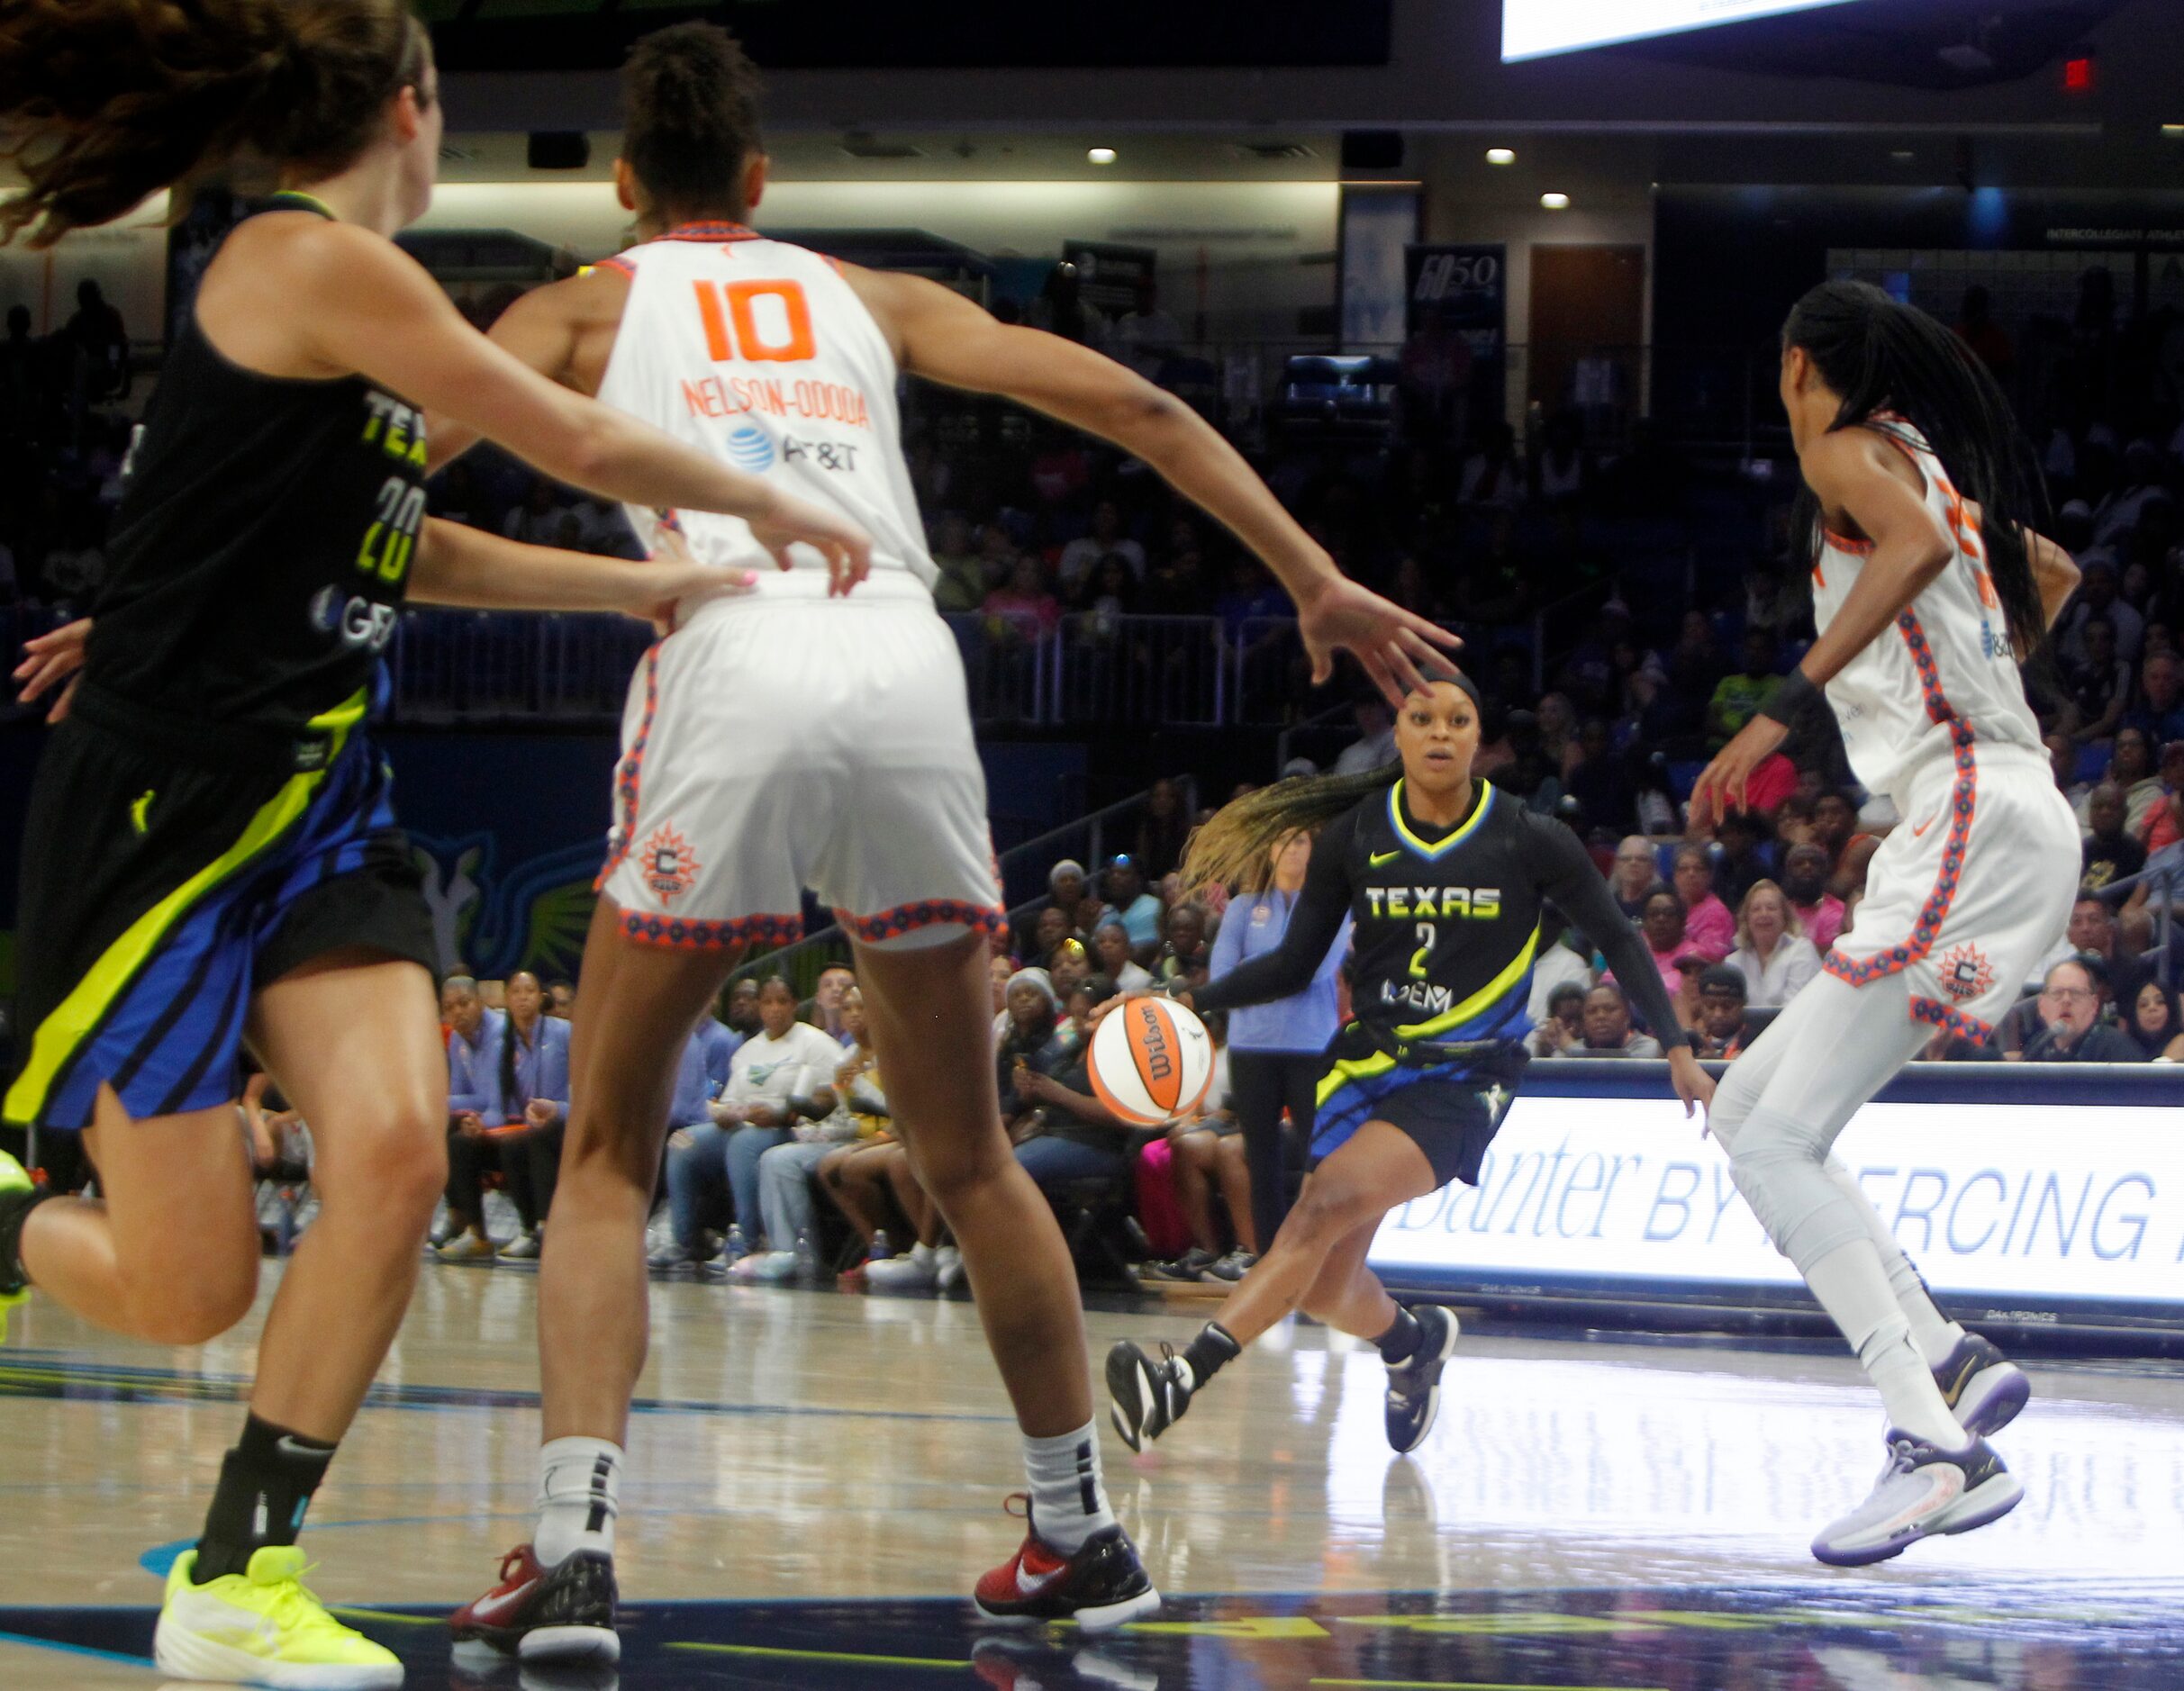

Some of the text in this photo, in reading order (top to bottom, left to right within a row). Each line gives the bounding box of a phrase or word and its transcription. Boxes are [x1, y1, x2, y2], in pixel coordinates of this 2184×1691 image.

[692, 278, 818, 362] 10
[681, 375, 872, 430] NELSON-ODODA
[782, 435, 857, 472] AT&T
[357, 475, 427, 582] 20
[655, 848, 679, 876] C
[1364, 885, 1501, 918] TEXAS
[1408, 921, 1436, 979] 2
[1953, 960, 1978, 983] C
[1140, 1004, 1173, 1081] Wilson
[1641, 1160, 1741, 1245] BY
